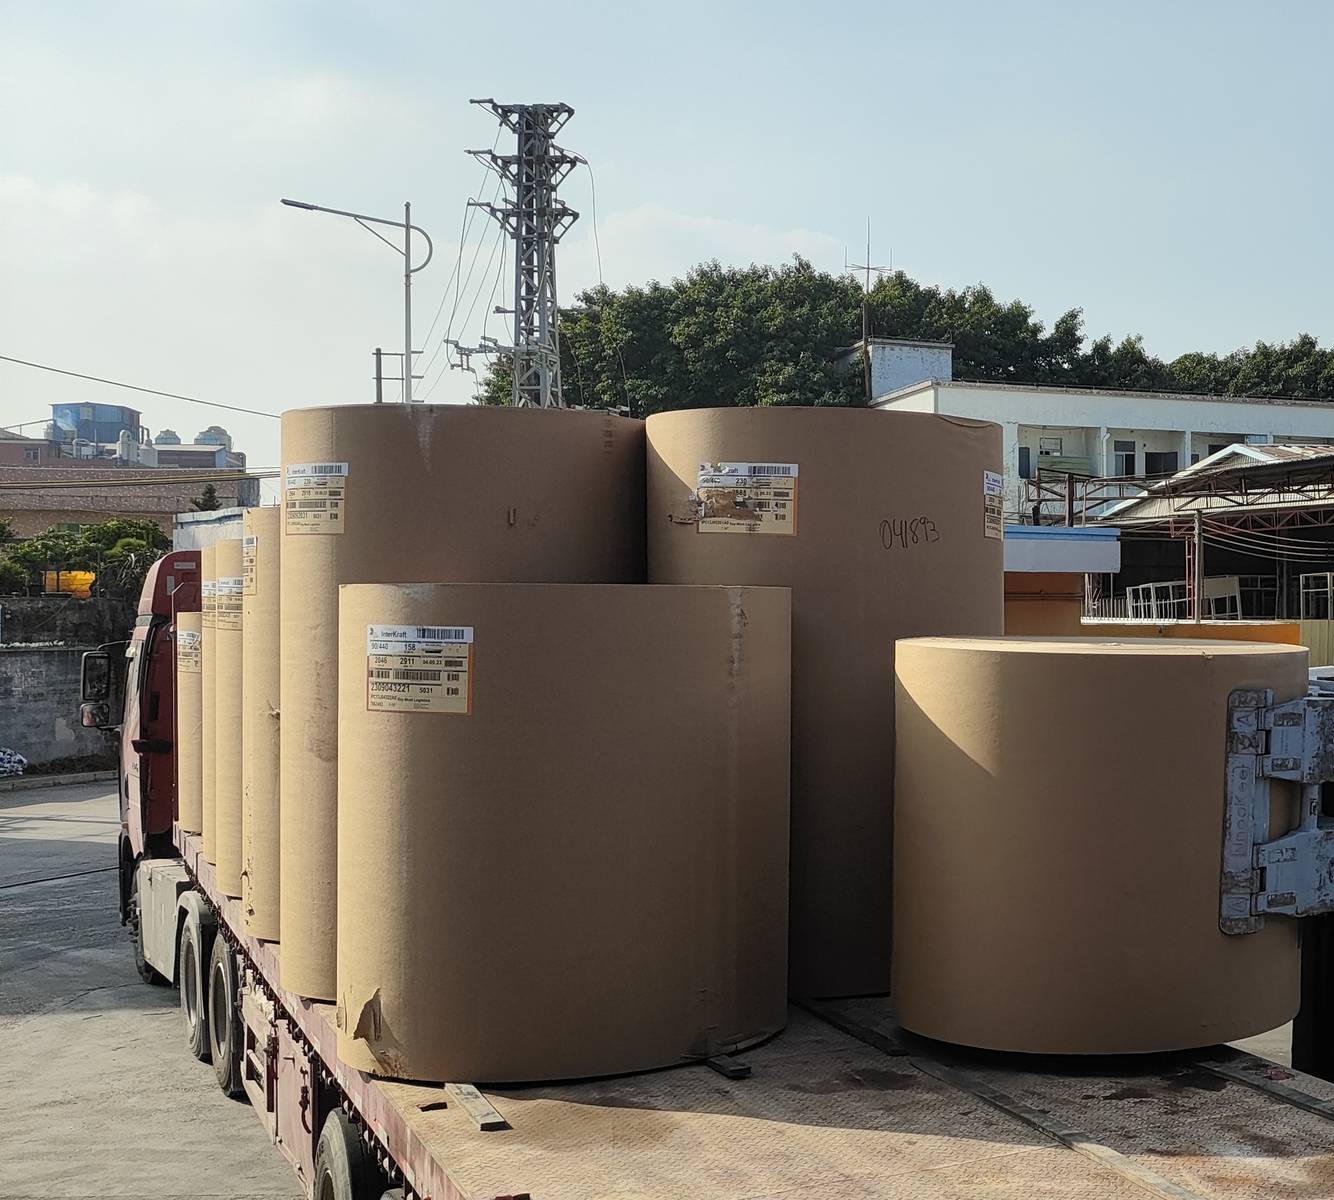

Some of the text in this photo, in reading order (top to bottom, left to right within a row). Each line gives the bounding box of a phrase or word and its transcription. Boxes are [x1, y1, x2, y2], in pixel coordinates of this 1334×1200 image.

[879, 516, 941, 550] 041893
[404, 643, 417, 651] 158
[399, 657, 415, 665] 2911
